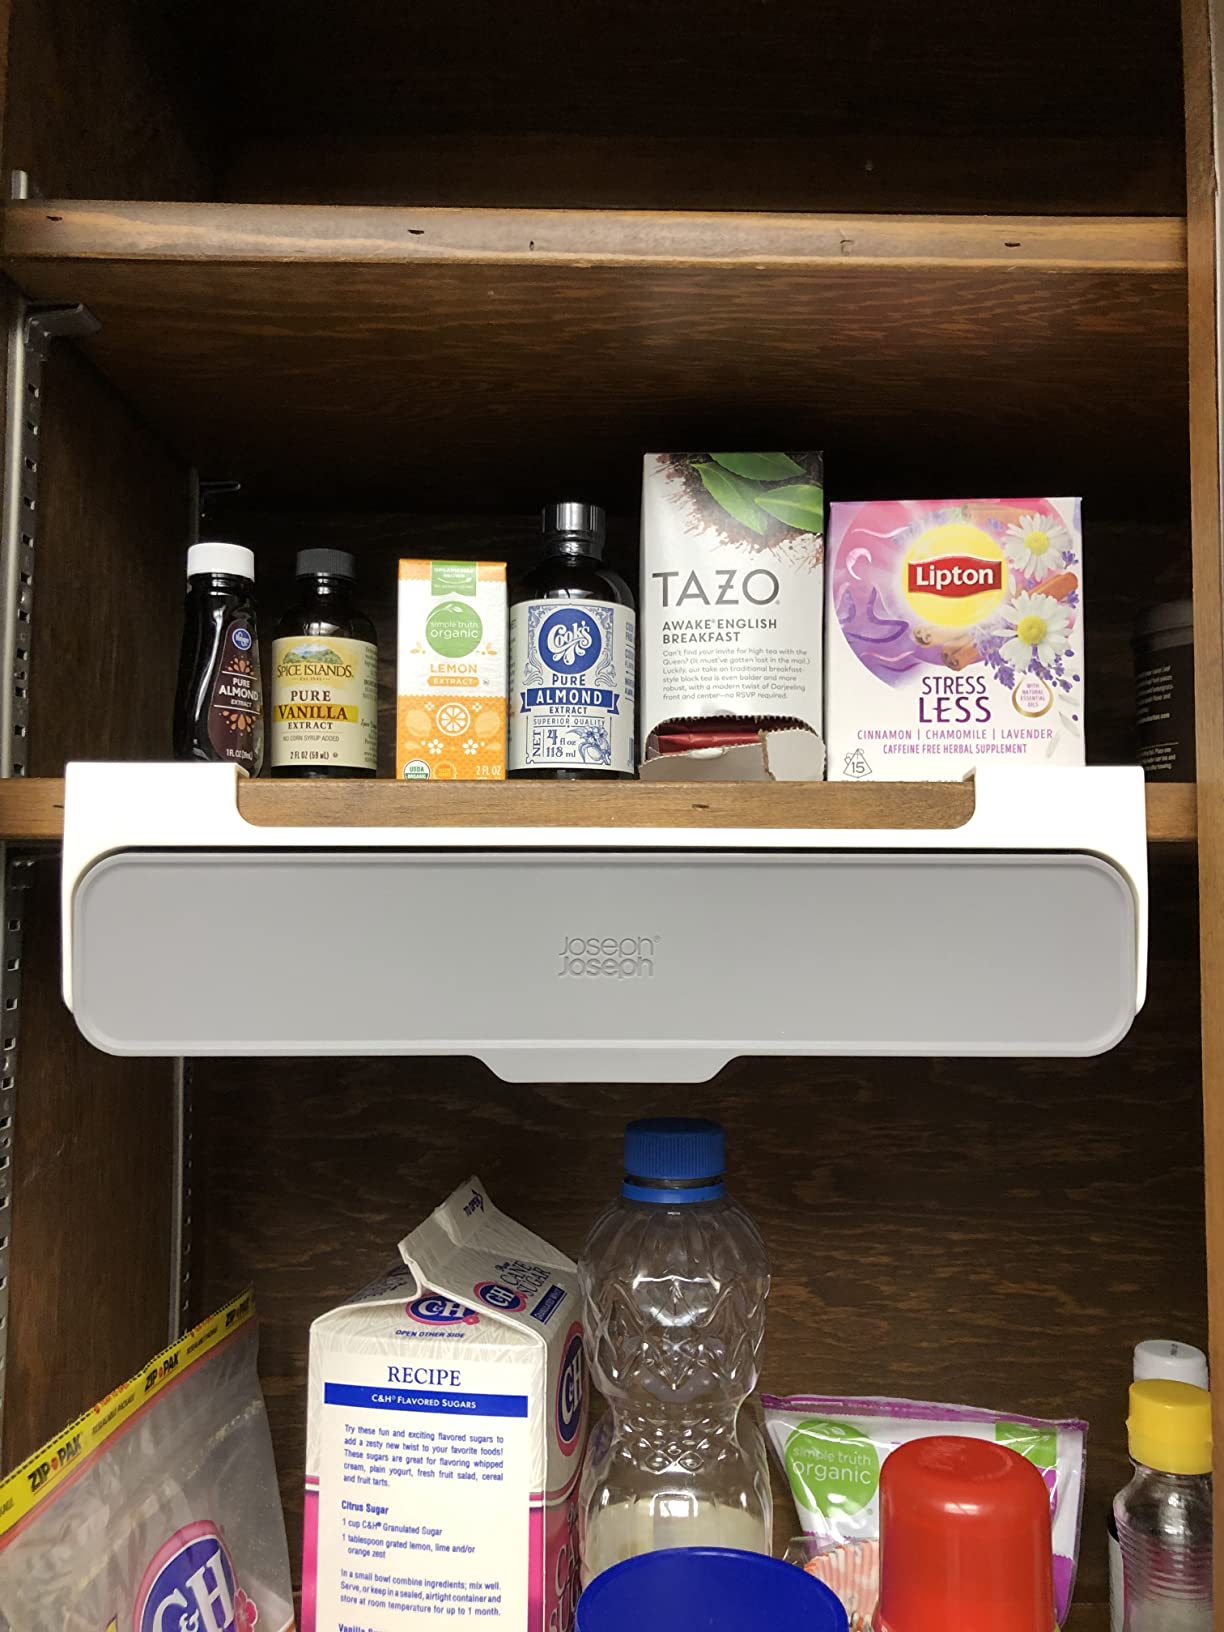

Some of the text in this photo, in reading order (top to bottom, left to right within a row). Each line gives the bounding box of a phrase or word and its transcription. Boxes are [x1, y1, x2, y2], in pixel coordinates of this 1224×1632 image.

[916, 565, 993, 590] Lipton
[652, 569, 779, 607] TAZO
[717, 618, 777, 629] ENGLISH
[431, 629, 478, 639] organic
[547, 620, 593, 655] Cook's
[663, 632, 740, 644] BREAKFAST
[430, 664, 477, 673] LEMON
[729, 657, 753, 665] gotten
[277, 664, 352, 678] SPICE ISLANDS
[730, 665, 767, 673] traditional
[233, 678, 250, 688] PURE
[552, 674, 586, 686] PURE
[922, 675, 986, 695] STRESS
[219, 685, 258, 700] ALMOND
[291, 691, 331, 701] PURE
[536, 689, 602, 705] ALMOND
[682, 691, 756, 700] and RSVP
[231, 699, 252, 708] EXTRACT
[549, 707, 587, 715] EXTRACT
[919, 696, 992, 723] LESS
[279, 704, 348, 720] VANILLA
[574, 718, 605, 726] QUALITY
[857, 729, 1053, 740] CINNAMON CHAMOMILE LAVENDER
[532, 730, 541, 757] NET
[883, 743, 1027, 755] CAFFEINE FREE HERBAL SUPPLEMENT
[546, 746, 576, 758] 118 ml
[476, 766, 501, 775] 2 FL OZ
[851, 762, 866, 774] 15
[501, 1261, 532, 1285] CANE
[517, 1268, 551, 1297] SUGAR
[145, 1351, 180, 1392] ZIP PAK
[387, 1366, 461, 1386] RECIPE
[398, 1396, 476, 1409] FLAVORED SUGARS
[345, 1424, 355, 1434] Try
[358, 1426, 376, 1435] these
[378, 1427, 389, 1436] fun
[393, 1429, 405, 1438] and
[408, 1430, 435, 1441] exciting
[438, 1432, 466, 1441] flavored
[496, 1435, 504, 1443] to
[344, 1437, 356, 1445] add
[366, 1440, 383, 1449] zesty
[403, 1443, 419, 1451] twist
[422, 1444, 429, 1452] to
[432, 1446, 448, 1454] your
[451, 1445, 477, 1455] favorite
[480, 1447, 504, 1456] foods!
[28, 1434, 80, 1492] ZIP PAK
[344, 1449, 363, 1458] These
[366, 1452, 389, 1462] sugars
[405, 1456, 423, 1465] great
[426, 1457, 436, 1465] for
[439, 1457, 470, 1468] flavoring
[473, 1460, 503, 1470] whipped
[838, 1451, 871, 1465] truth
[343, 1463, 503, 1481] cream, plain yogurt, fresh fruit salad, cereal
[792, 1461, 871, 1484] organic
[343, 1474, 390, 1487] and fruit tarts.
[341, 1500, 389, 1515] Citrus Sugar
[348, 1520, 442, 1537] cup Granulated Sugar
[348, 1535, 475, 1553] tablespoon grated lemon, lime and/or
[348, 1547, 386, 1558] orange zest
[341, 1568, 348, 1577] In
[355, 1572, 373, 1581] small
[374, 1574, 391, 1582] bowl
[392, 1576, 422, 1586] combine
[469, 1581, 482, 1590] mix
[484, 1582, 501, 1590] well.
[340, 1581, 361, 1592] Serve,
[370, 1586, 386, 1596] keep
[400, 1590, 424, 1600] sealed,
[425, 1592, 451, 1602] airtight
[452, 1593, 487, 1603] container
[487, 1595, 501, 1603] and
[340, 1594, 501, 1616] store at room temperature for up to month.
